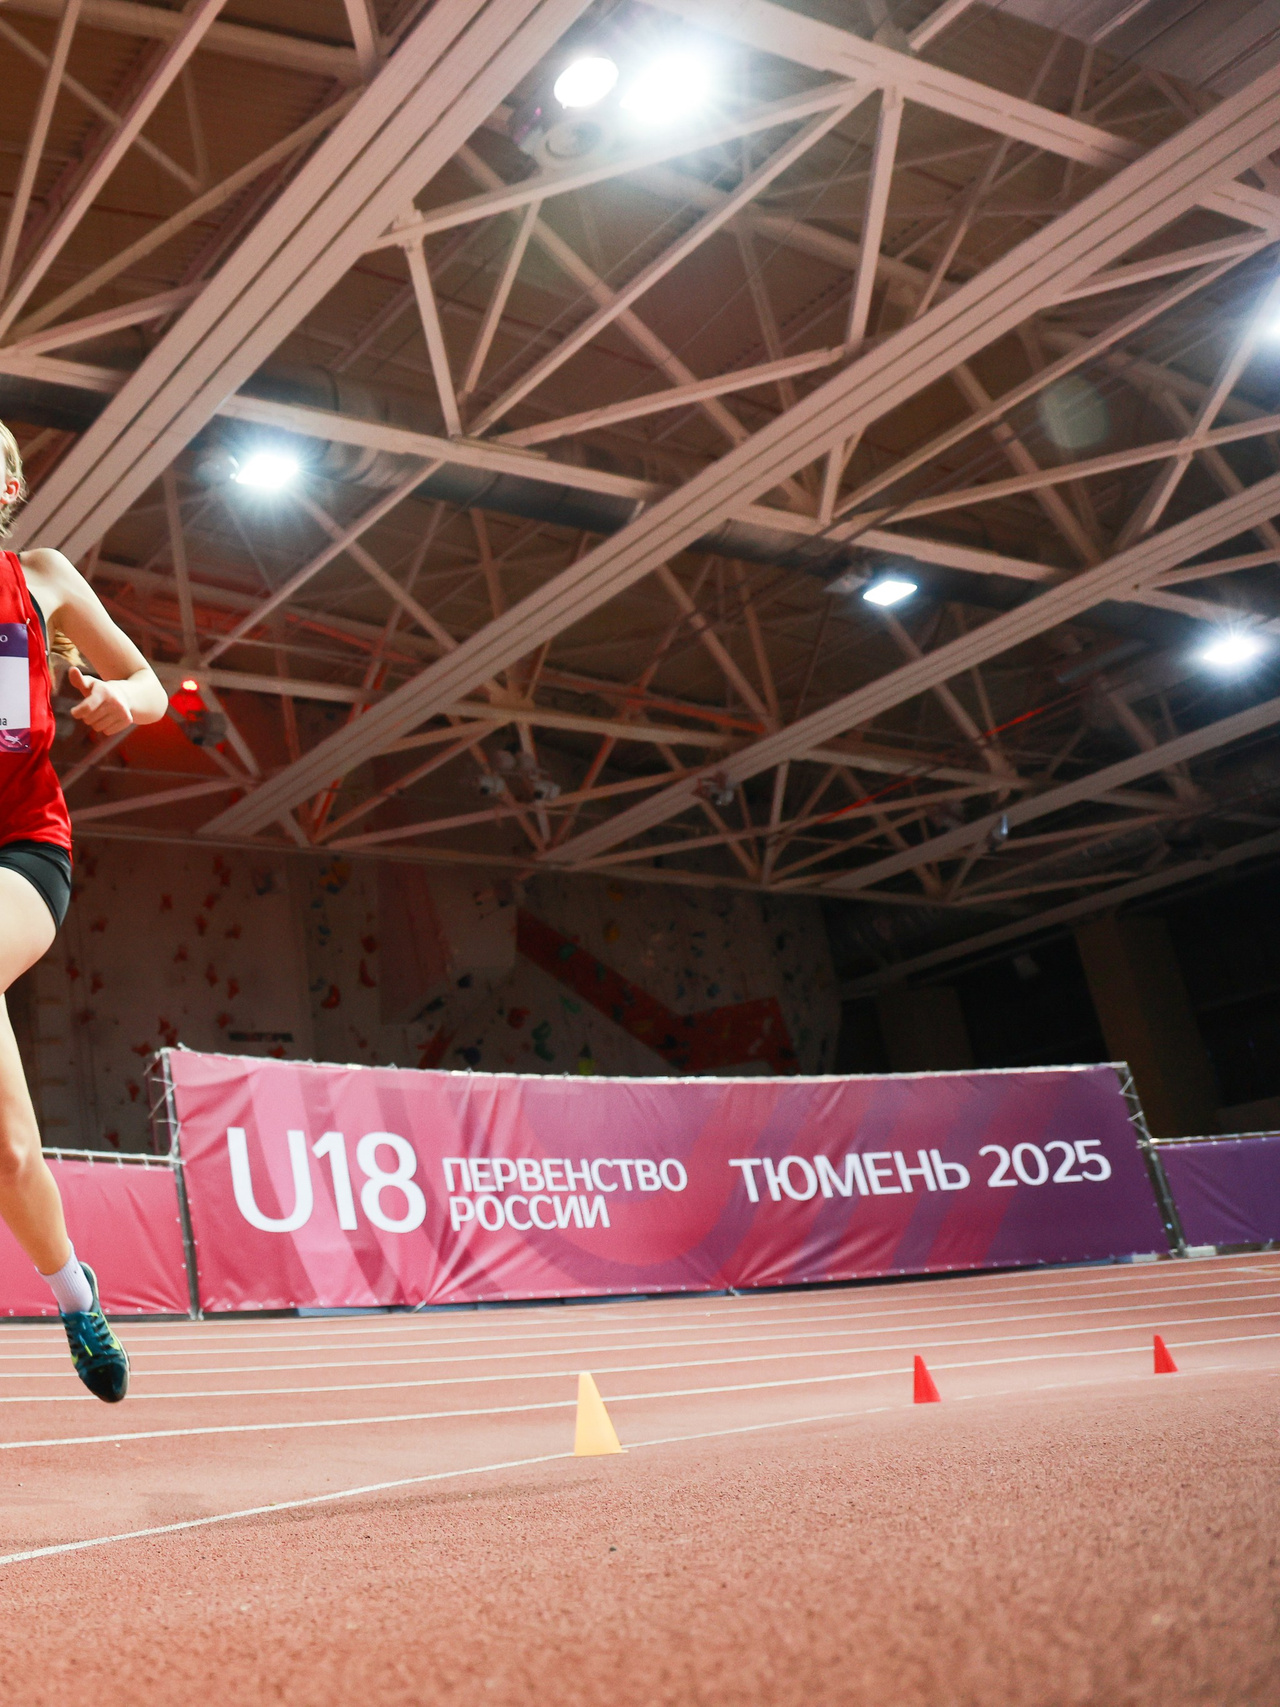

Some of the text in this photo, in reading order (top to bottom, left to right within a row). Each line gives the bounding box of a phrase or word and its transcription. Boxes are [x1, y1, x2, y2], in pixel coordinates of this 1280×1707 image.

[228, 1127, 426, 1235] U18
[442, 1157, 689, 1194] ПЕРВЕНСТВО
[728, 1139, 1113, 1203] ТЮМЕНЬ 2025
[449, 1194, 611, 1232] РОССИИ
